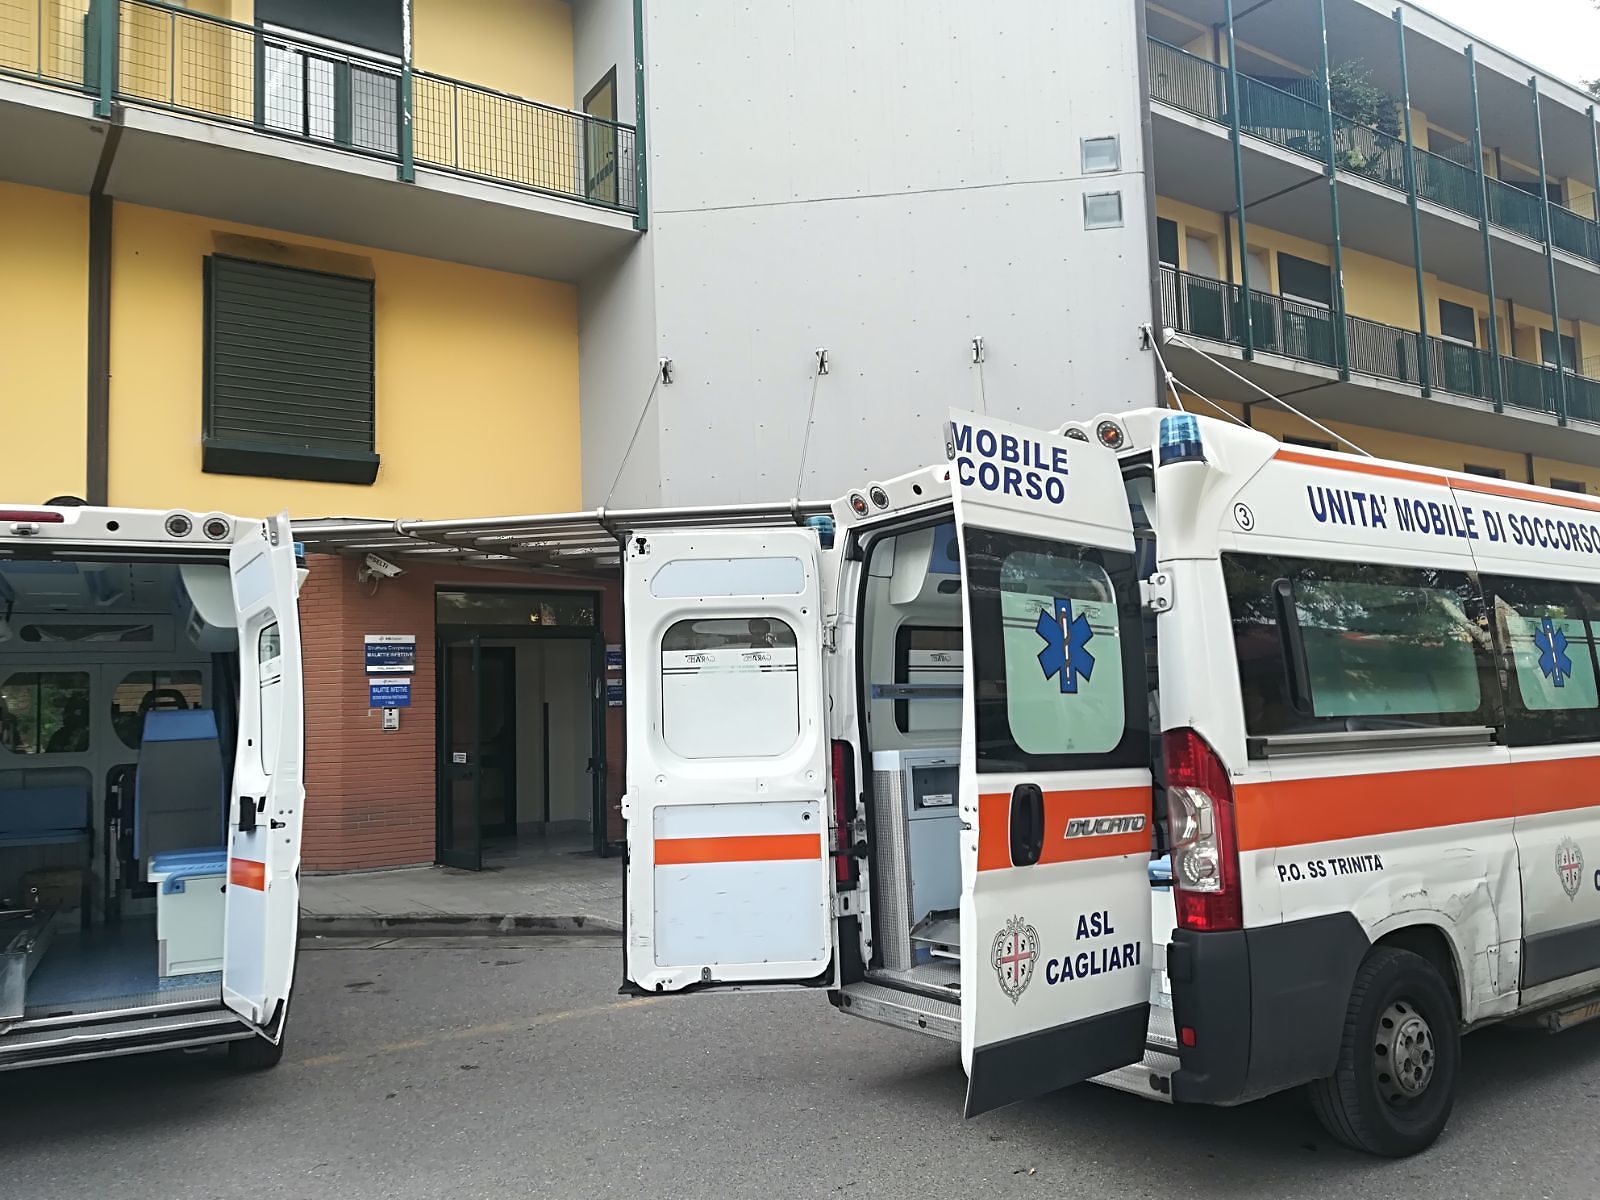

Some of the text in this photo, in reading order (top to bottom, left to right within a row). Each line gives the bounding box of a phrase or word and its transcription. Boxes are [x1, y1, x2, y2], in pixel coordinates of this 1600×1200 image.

[950, 421, 1069, 475] MOBILE
[957, 456, 1065, 505] CORSO
[1239, 507, 1250, 527] 3
[1392, 497, 1480, 540] MOBILE
[1482, 510, 1507, 543] DI
[1508, 513, 1600, 555] SOCCORSO
[1065, 815, 1146, 838] DUCATO
[1277, 864, 1305, 882] P.O.
[1307, 861, 1327, 878] SS
[1076, 911, 1114, 940] ASL
[1046, 942, 1141, 985] CAGLIARI
